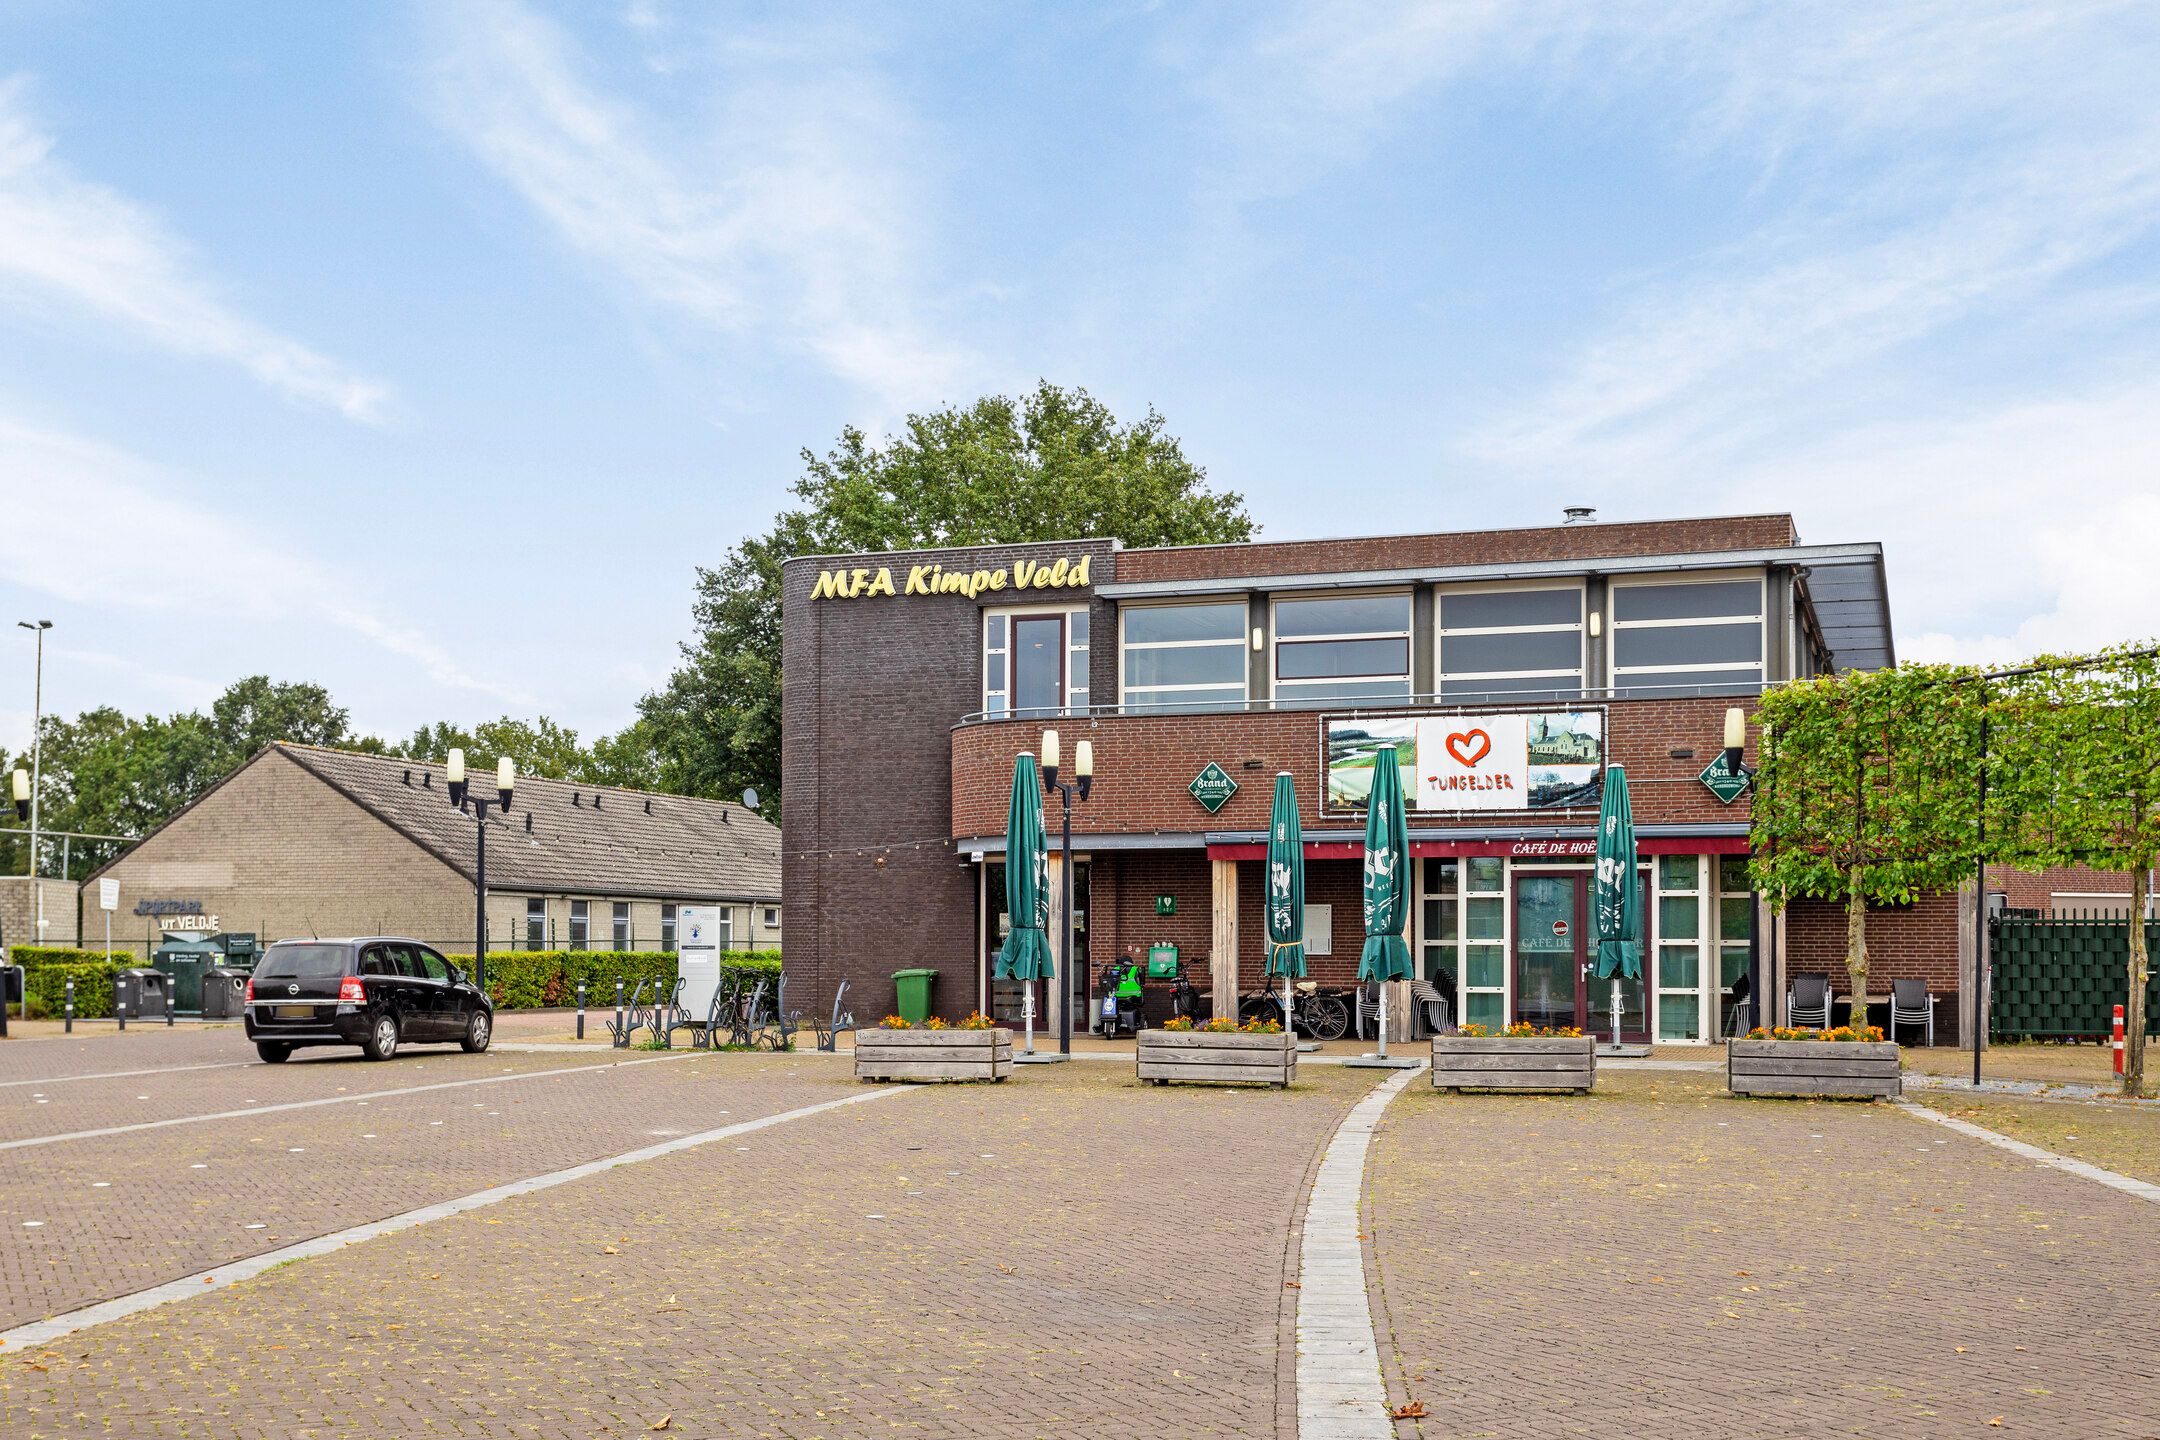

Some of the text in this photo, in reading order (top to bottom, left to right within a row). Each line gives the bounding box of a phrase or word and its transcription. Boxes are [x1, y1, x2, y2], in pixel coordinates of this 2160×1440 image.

[809, 554, 1092, 600] MFA Kimpe Veld
[1197, 777, 1228, 789] Brand
[1427, 773, 1514, 792] TUNGELDER
[1512, 840, 1547, 854] CAFÉ
[1548, 843, 1567, 854] DE
[1556, 938, 1571, 948] DE
